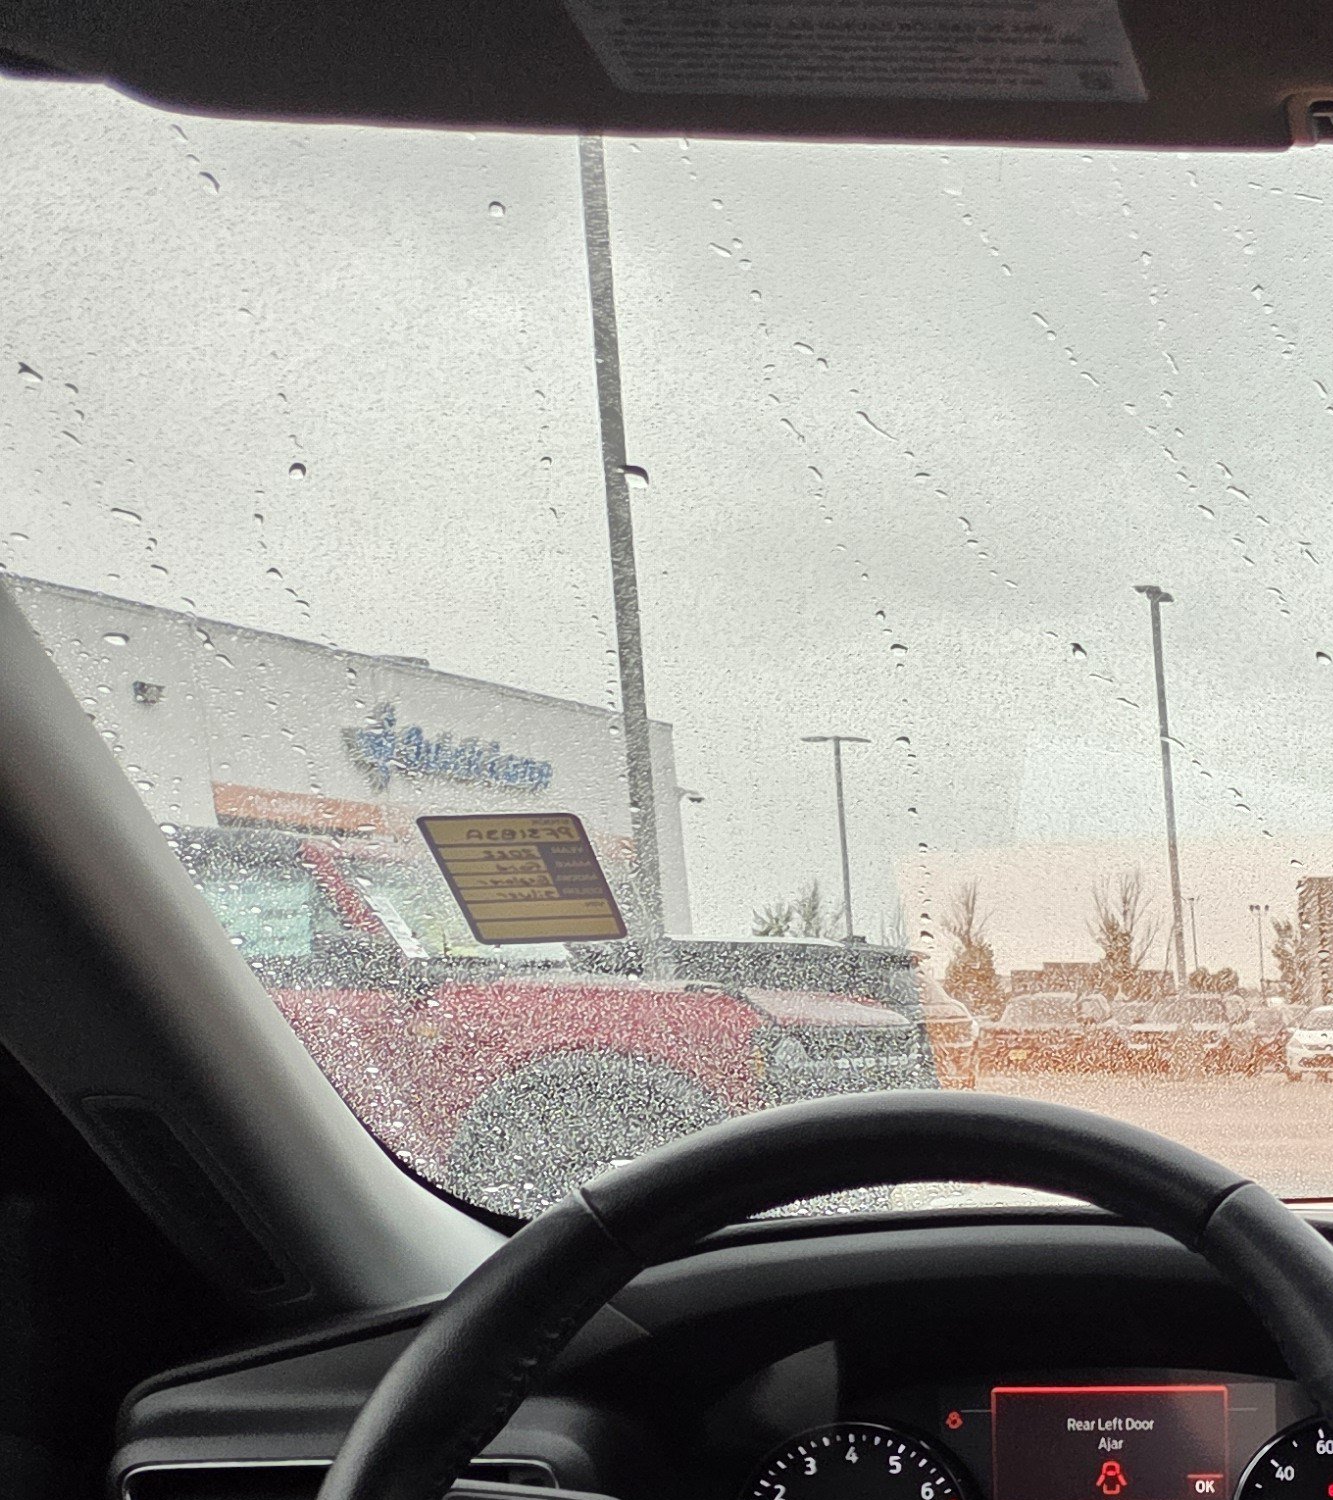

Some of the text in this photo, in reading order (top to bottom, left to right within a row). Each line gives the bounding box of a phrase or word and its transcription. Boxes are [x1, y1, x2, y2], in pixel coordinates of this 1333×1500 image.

[1066, 1417, 1155, 1432] Rear Left Door
[1097, 1436, 1125, 1454] Ajar
[844, 1446, 860, 1464] 4
[803, 1457, 818, 1476] 3
[888, 1455, 902, 1475] 5
[1274, 1464, 1296, 1481] 40
[920, 1481, 935, 1500] 6
[1194, 1480, 1216, 1495] OK
